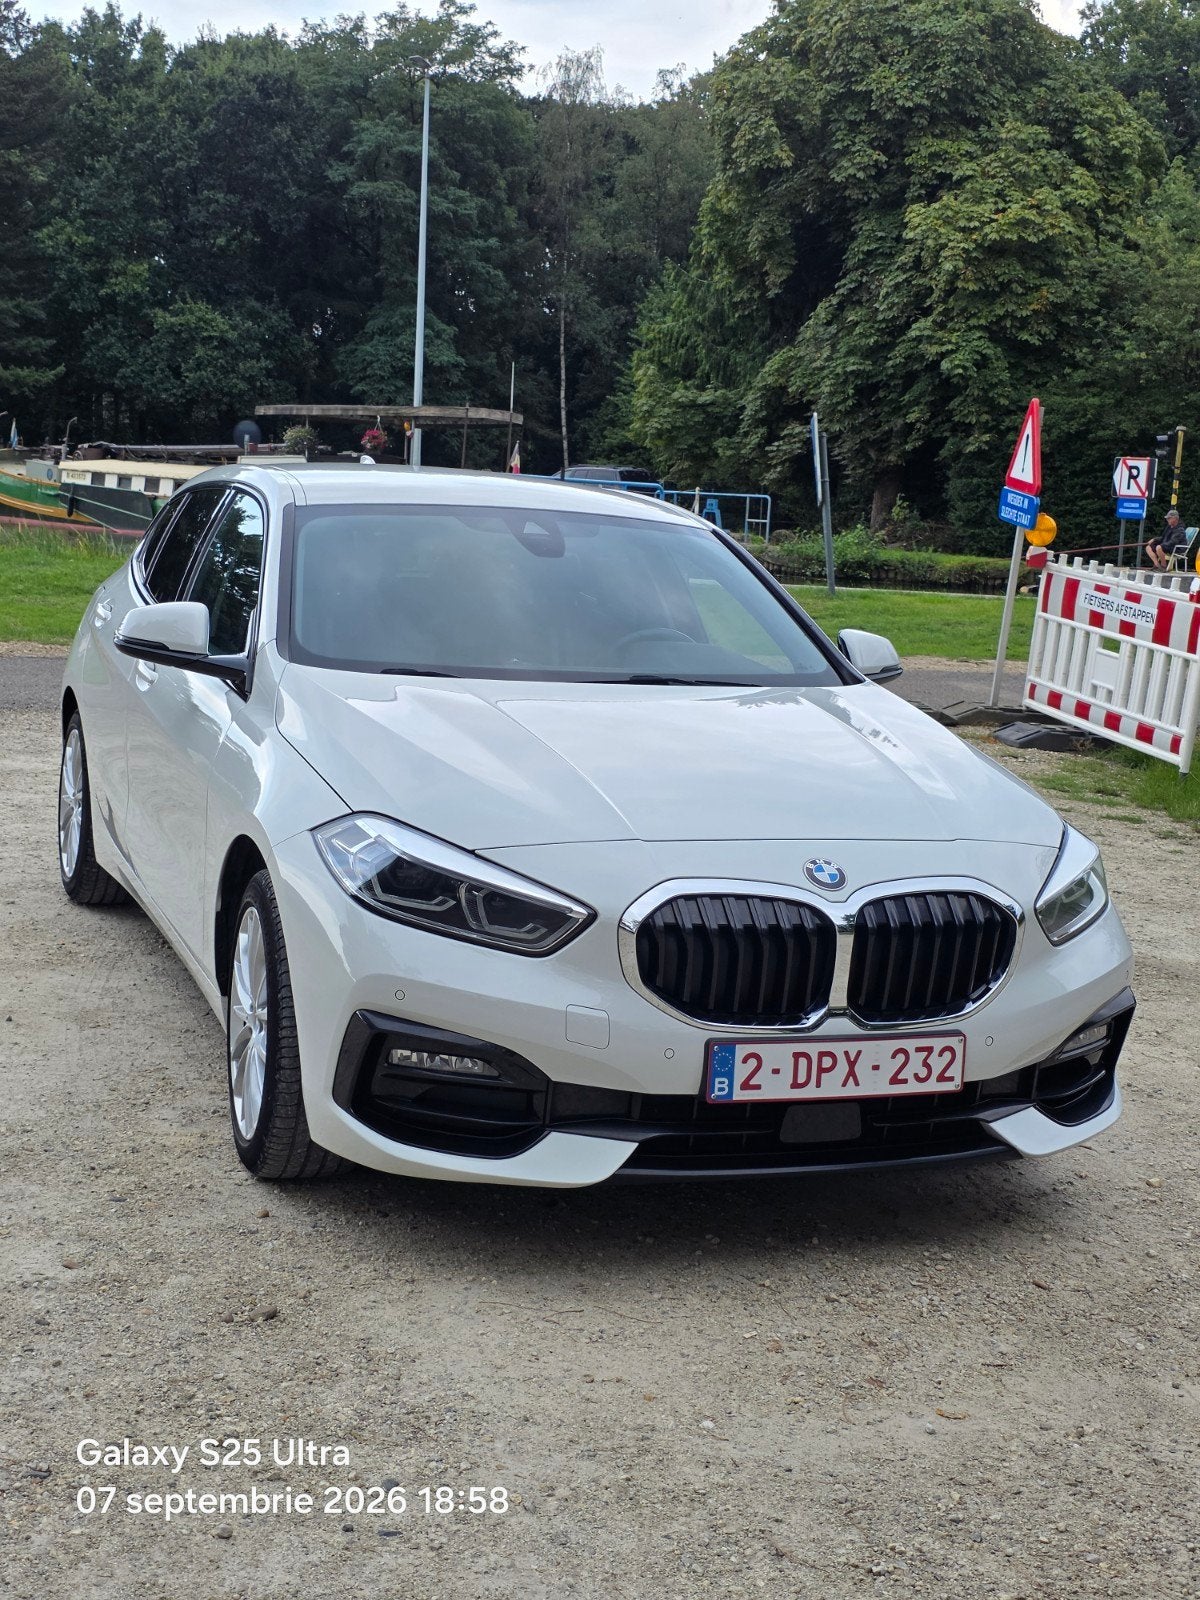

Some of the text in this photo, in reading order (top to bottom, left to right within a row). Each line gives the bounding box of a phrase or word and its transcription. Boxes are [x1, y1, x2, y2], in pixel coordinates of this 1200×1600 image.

[1017, 511, 1031, 526] STAAT
[1083, 593, 1155, 624] FIETSERS AFSTAPPEN
[714, 1078, 728, 1095] B
